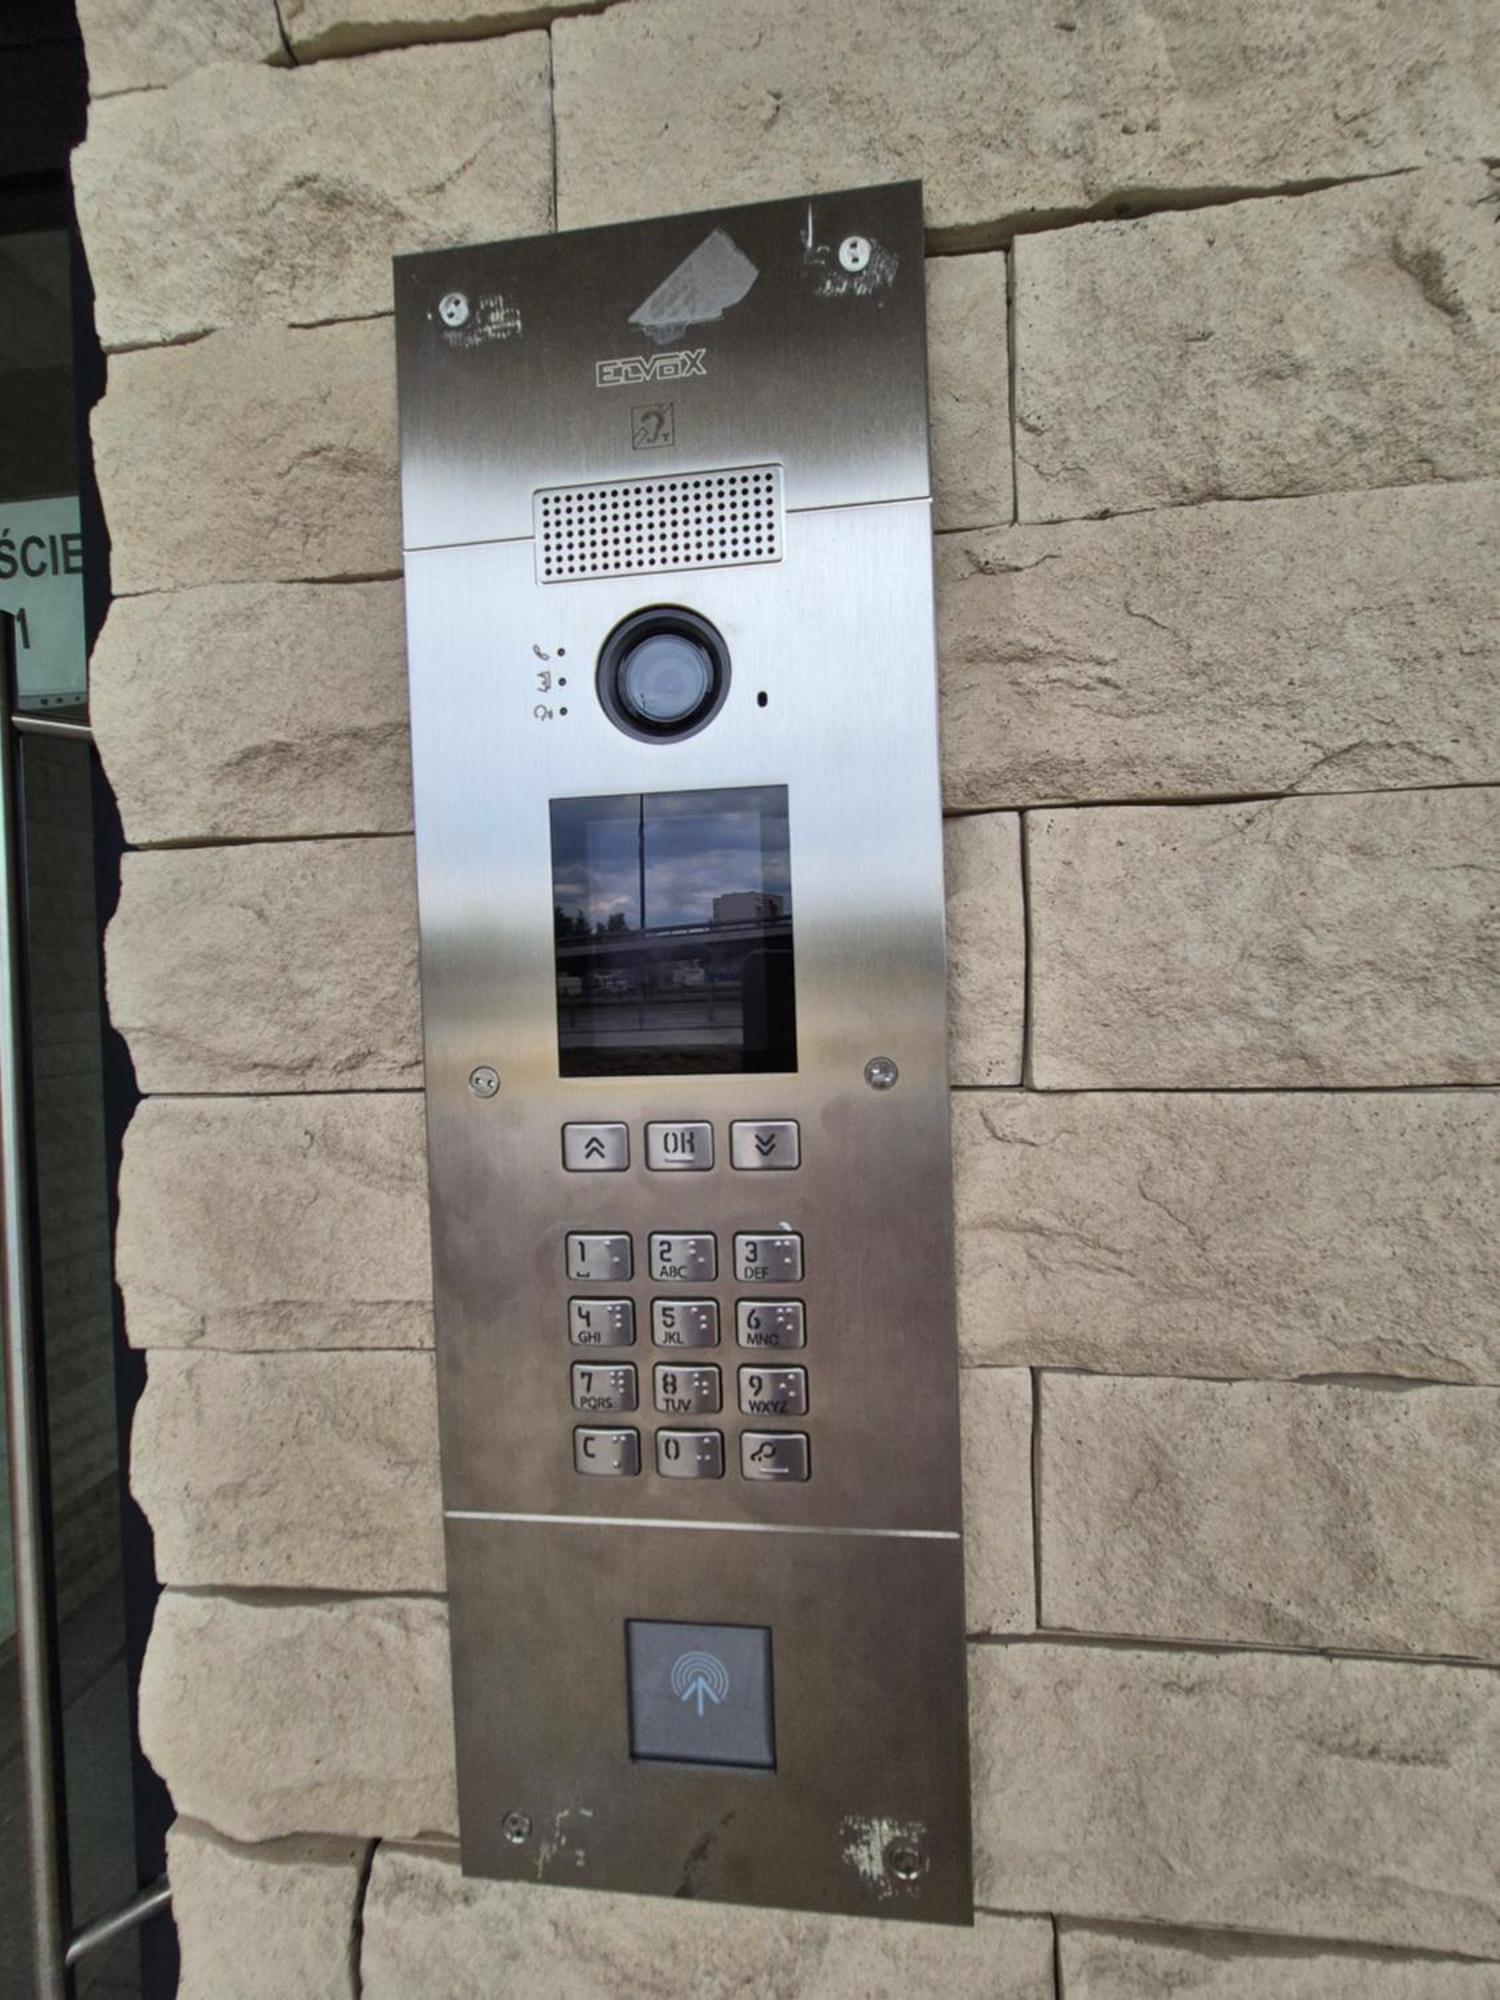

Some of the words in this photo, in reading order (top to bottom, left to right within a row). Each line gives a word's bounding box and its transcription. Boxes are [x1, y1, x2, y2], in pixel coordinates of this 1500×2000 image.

[596, 348, 707, 387] ELVOX
[663, 1132, 695, 1153] OK
[578, 1241, 585, 1262] 1
[659, 1240, 672, 1262] 2
[745, 1241, 757, 1263] 3
[659, 1266, 687, 1279] ABC
[744, 1267, 768, 1279] DEF
[577, 1306, 591, 1327] 4
[662, 1307, 675, 1328] 5
[747, 1309, 760, 1330] 6
[577, 1331, 601, 1343] GHI
[662, 1331, 684, 1344] JKL
[746, 1333, 780, 1346] MNO
[581, 1372, 592, 1393] 7
[662, 1373, 677, 1395] 8
[748, 1375, 763, 1397] 9
[580, 1396, 613, 1408] PQRS
[663, 1398, 692, 1412] TUV
[748, 1400, 787, 1413] WXYZ
[583, 1437, 596, 1458] C
[664, 1438, 680, 1460] 0
